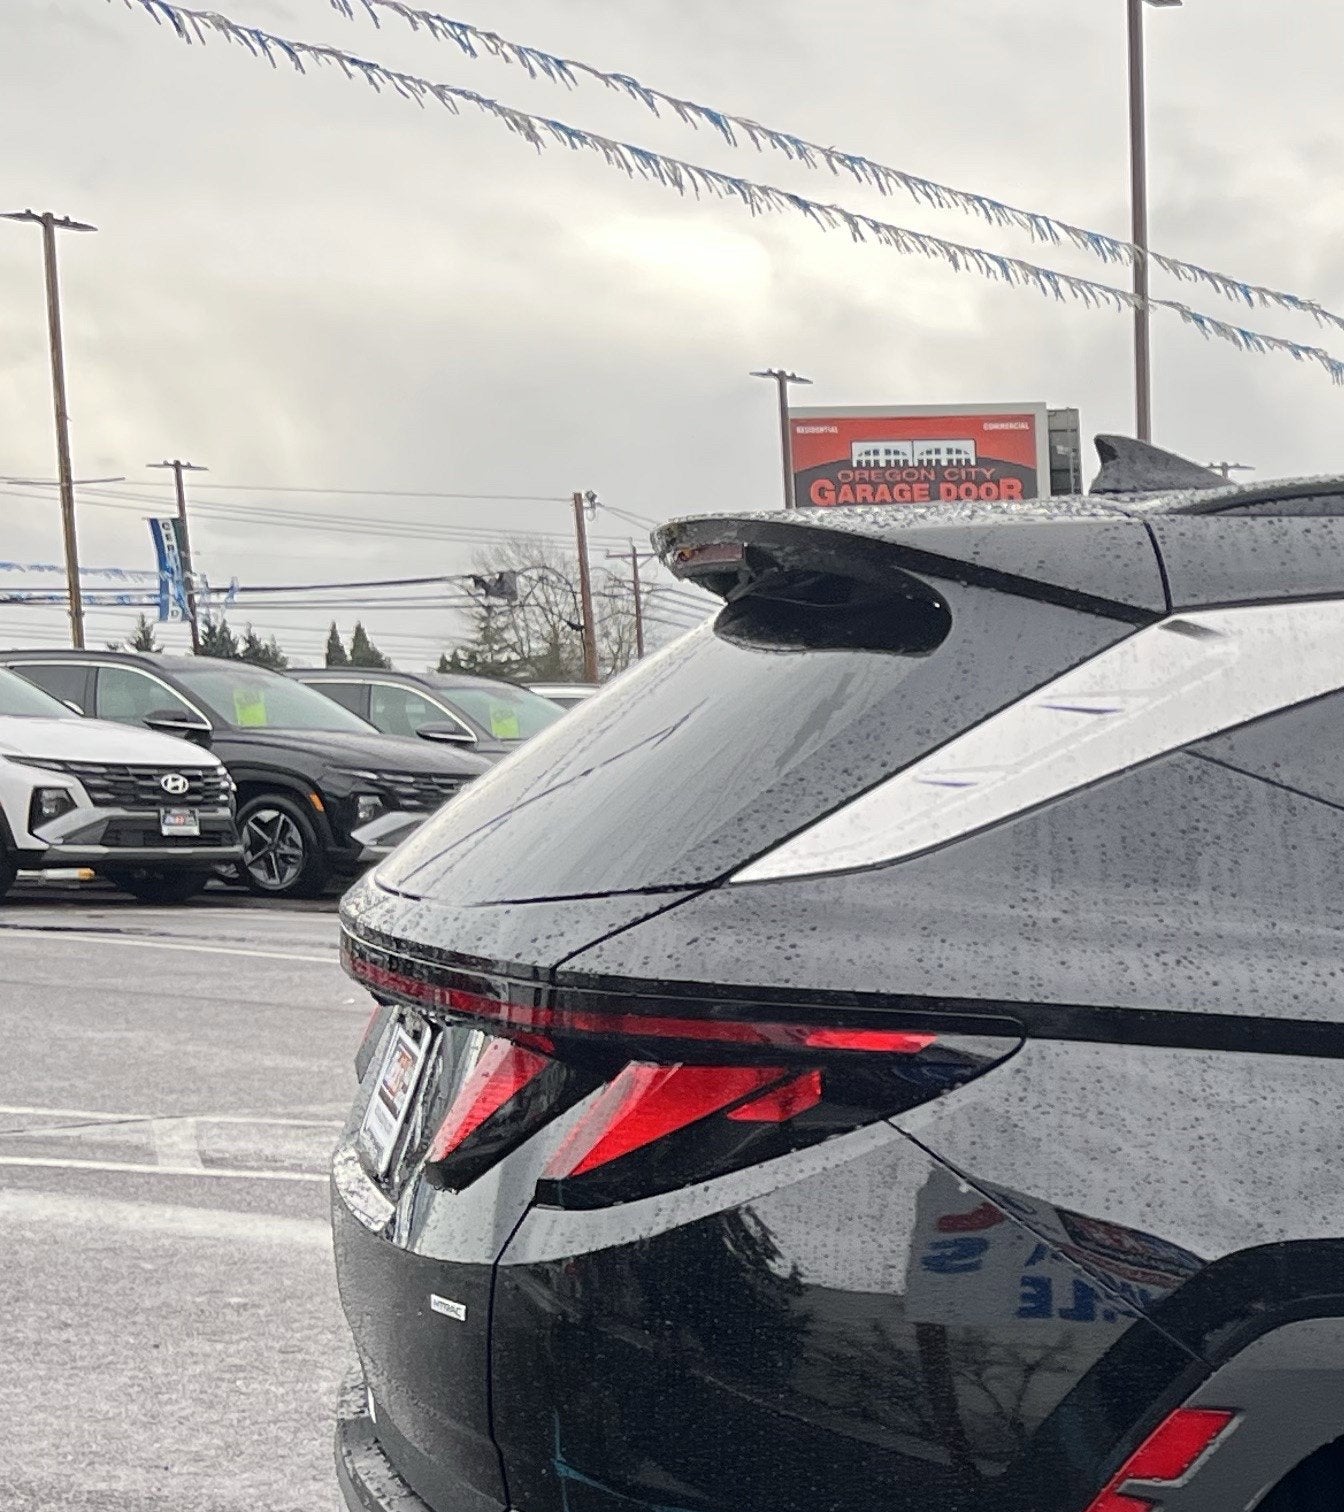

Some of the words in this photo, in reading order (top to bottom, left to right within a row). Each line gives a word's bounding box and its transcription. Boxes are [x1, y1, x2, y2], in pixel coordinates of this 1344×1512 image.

[982, 421, 1030, 431] COMMERCIAL
[837, 467, 936, 482] OREGON
[943, 466, 996, 481] CITY
[810, 478, 931, 506] GARAGE
[939, 476, 1024, 502] DOOR
